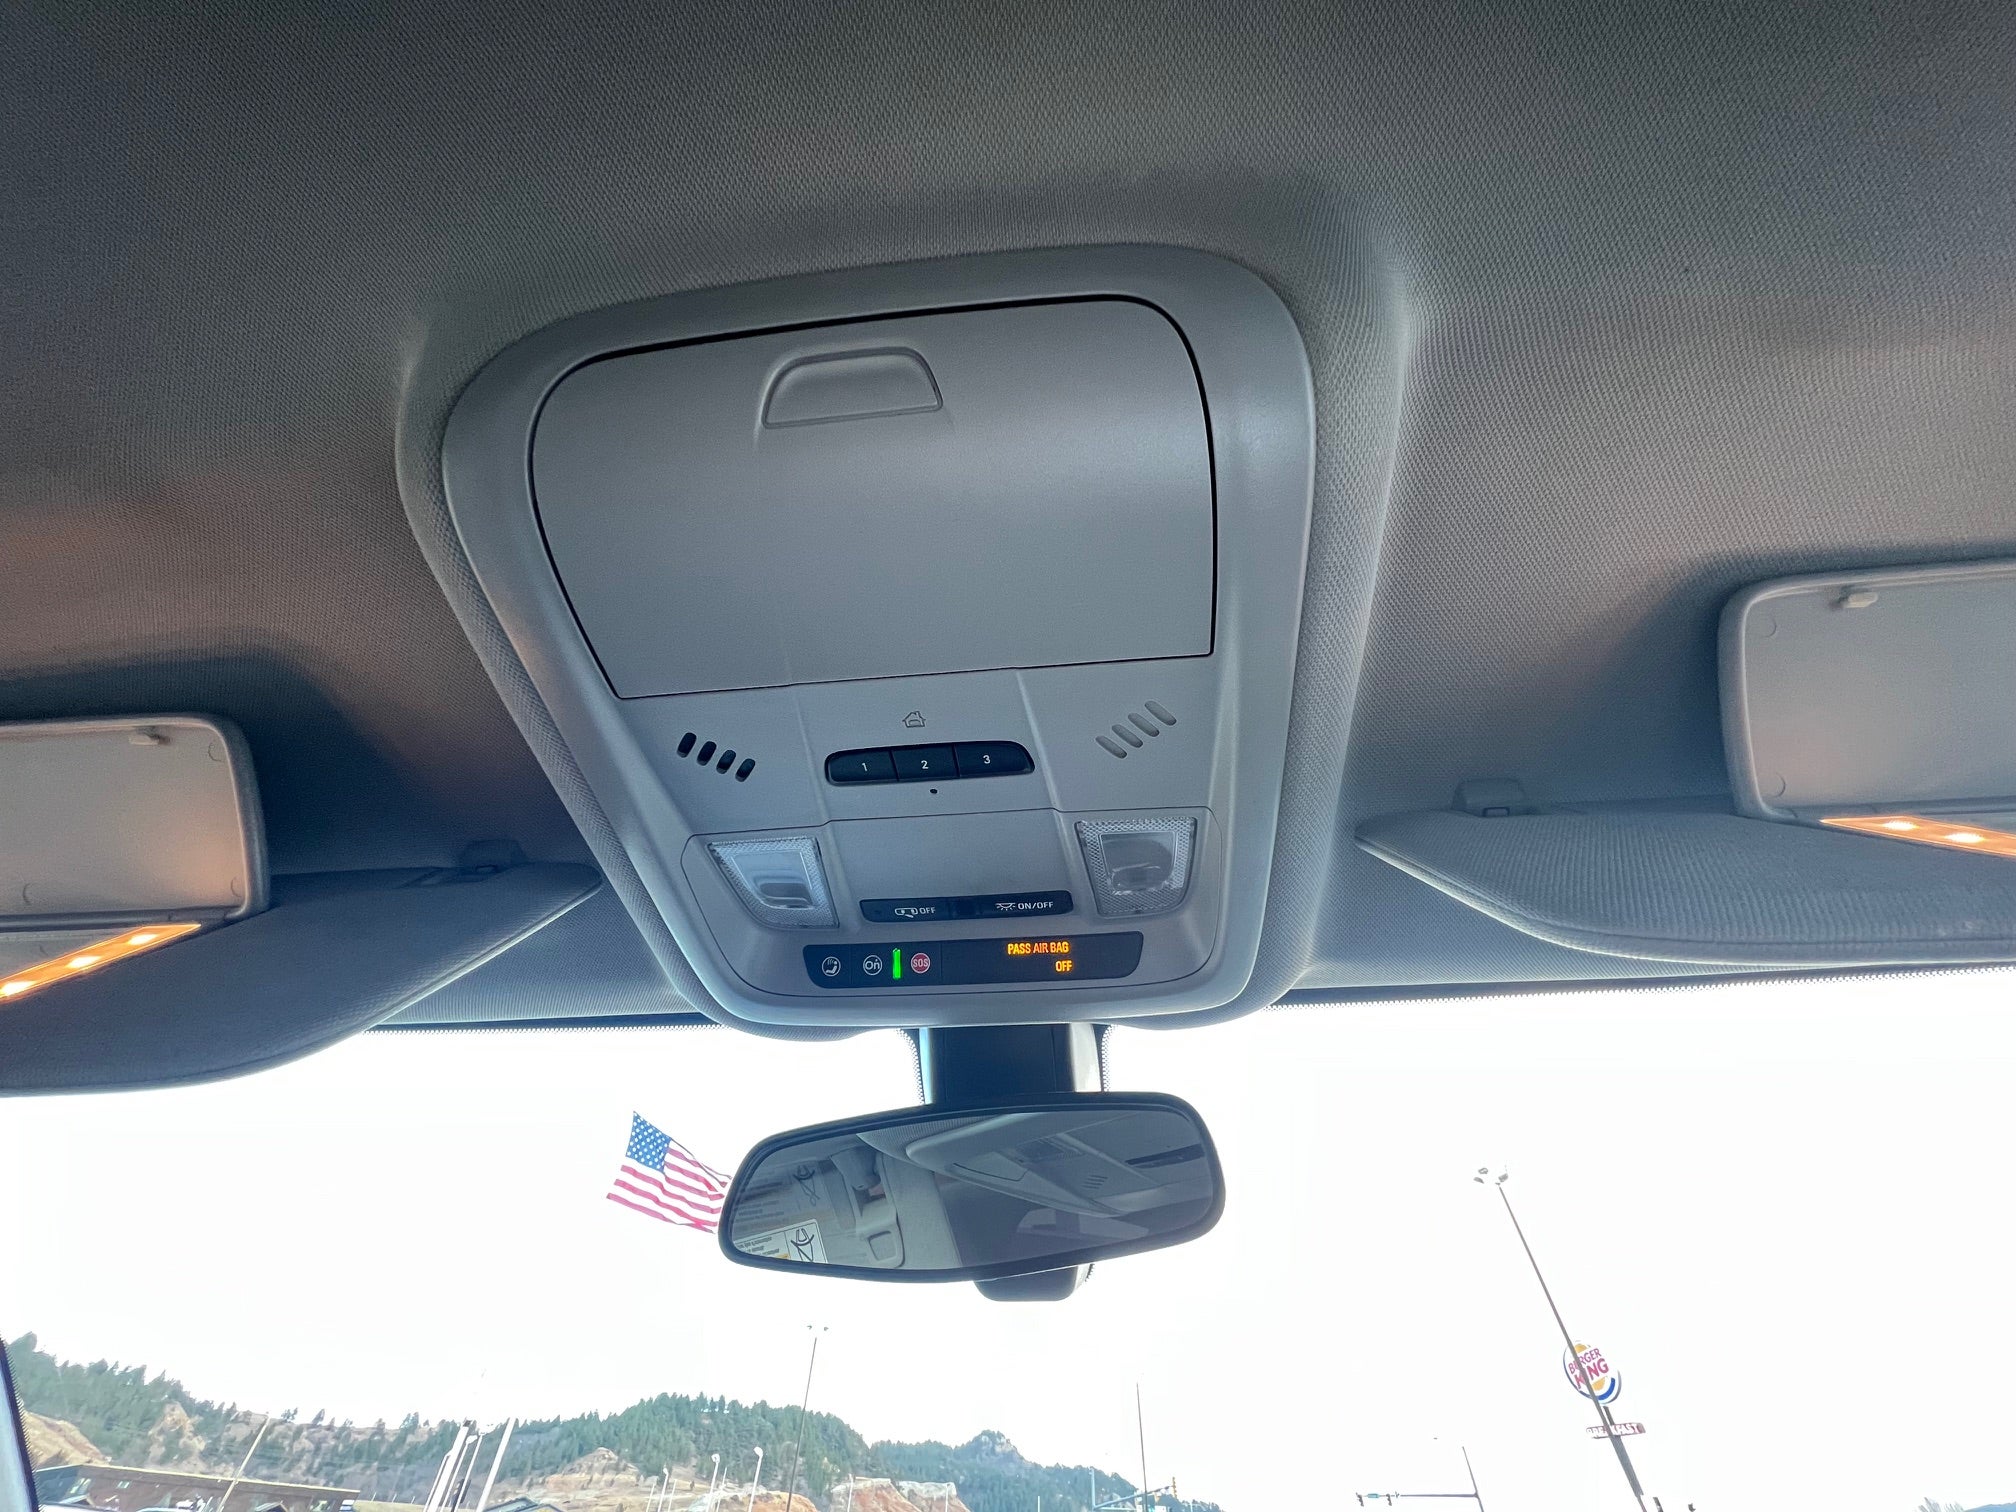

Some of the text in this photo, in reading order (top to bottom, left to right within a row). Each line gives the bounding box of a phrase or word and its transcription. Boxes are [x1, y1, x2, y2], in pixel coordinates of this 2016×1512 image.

[861, 754, 991, 772] 1 2 3
[919, 906, 936, 915] OFF
[1017, 901, 1054, 911] ON/OFF
[1007, 941, 1070, 955] PASS AIR BAG
[864, 958, 880, 971] On
[912, 958, 929, 968] SOS
[1055, 960, 1073, 972] OFF
[1574, 1358, 1609, 1389] KNG
